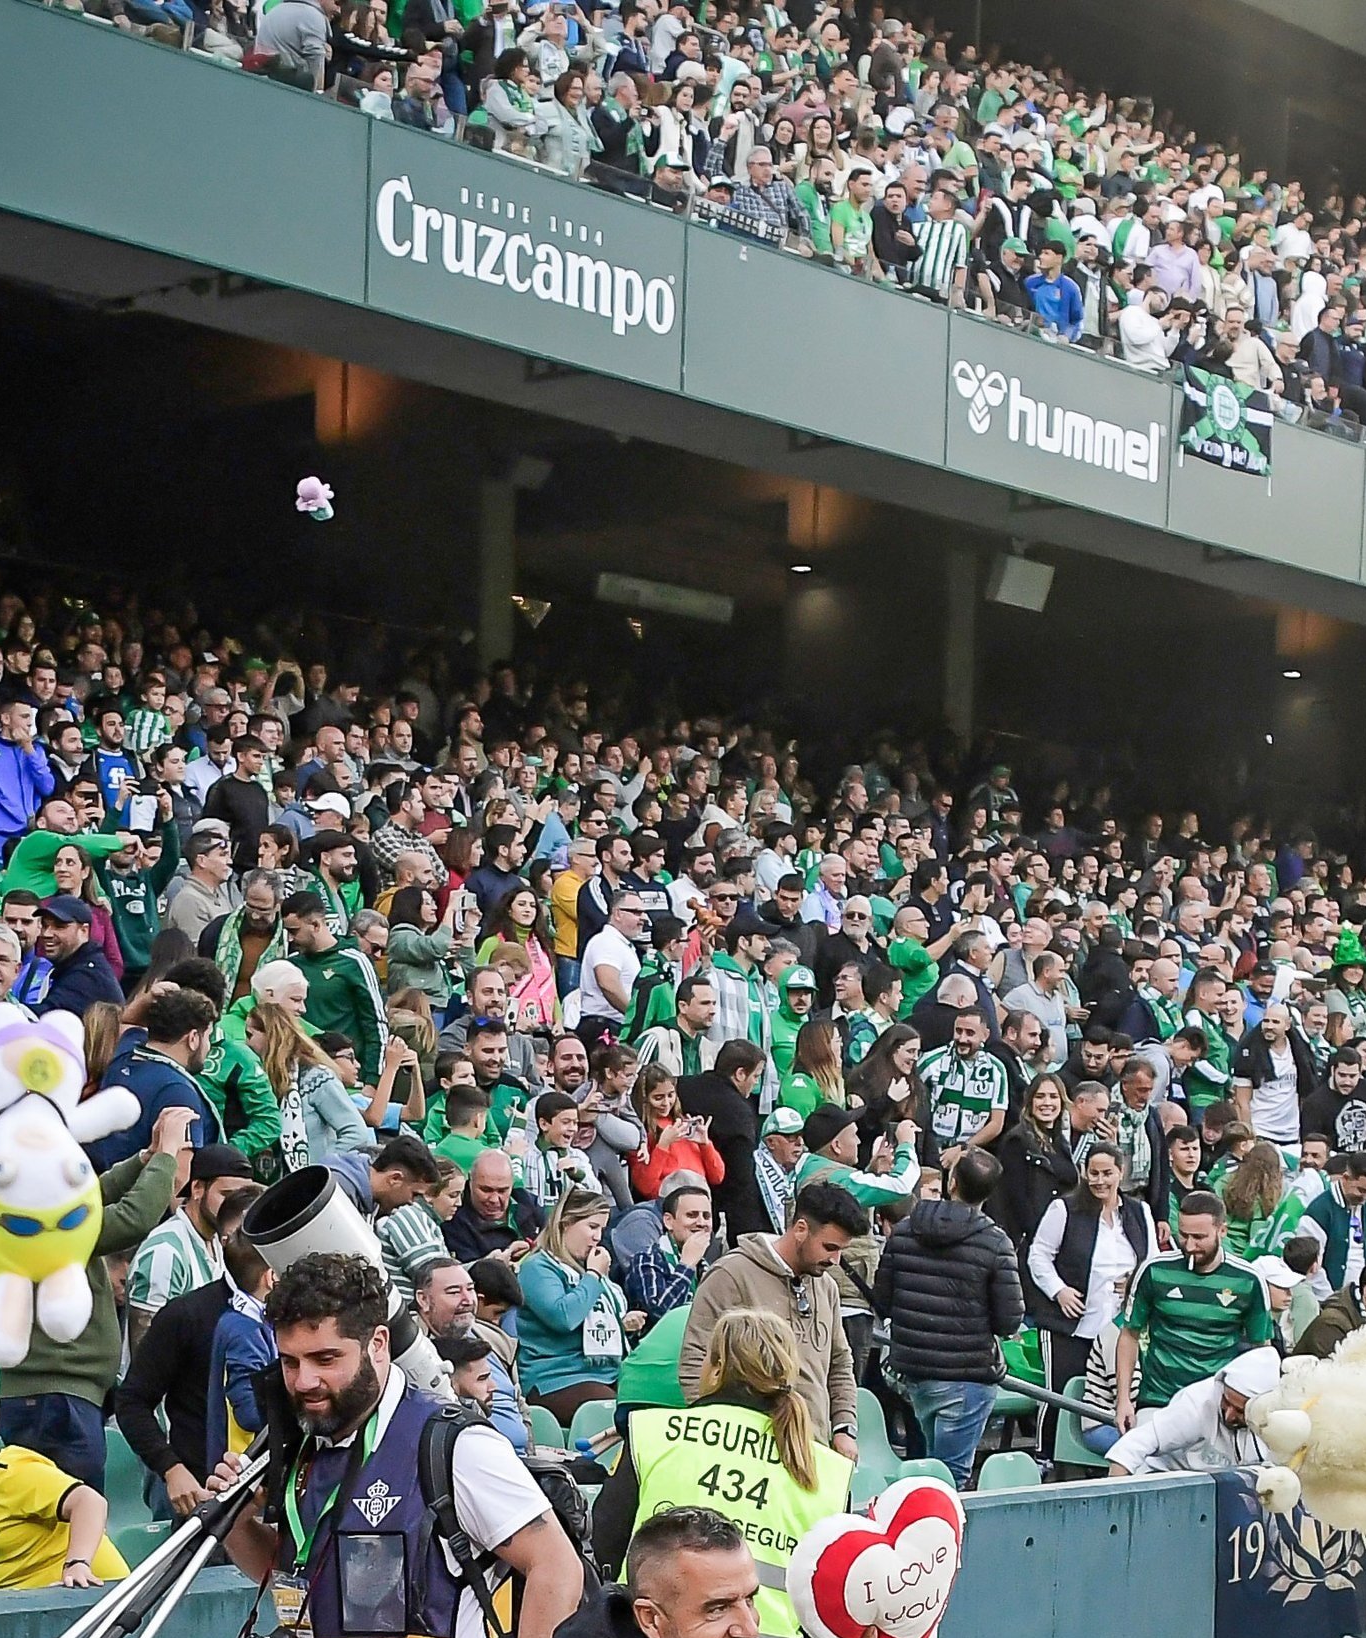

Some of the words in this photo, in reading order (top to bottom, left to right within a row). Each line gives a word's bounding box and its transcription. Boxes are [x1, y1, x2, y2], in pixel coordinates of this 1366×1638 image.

[375, 175, 676, 336] Cruzcampo
[1007, 376, 1160, 483] hummel
[697, 1463, 770, 1511] 434
